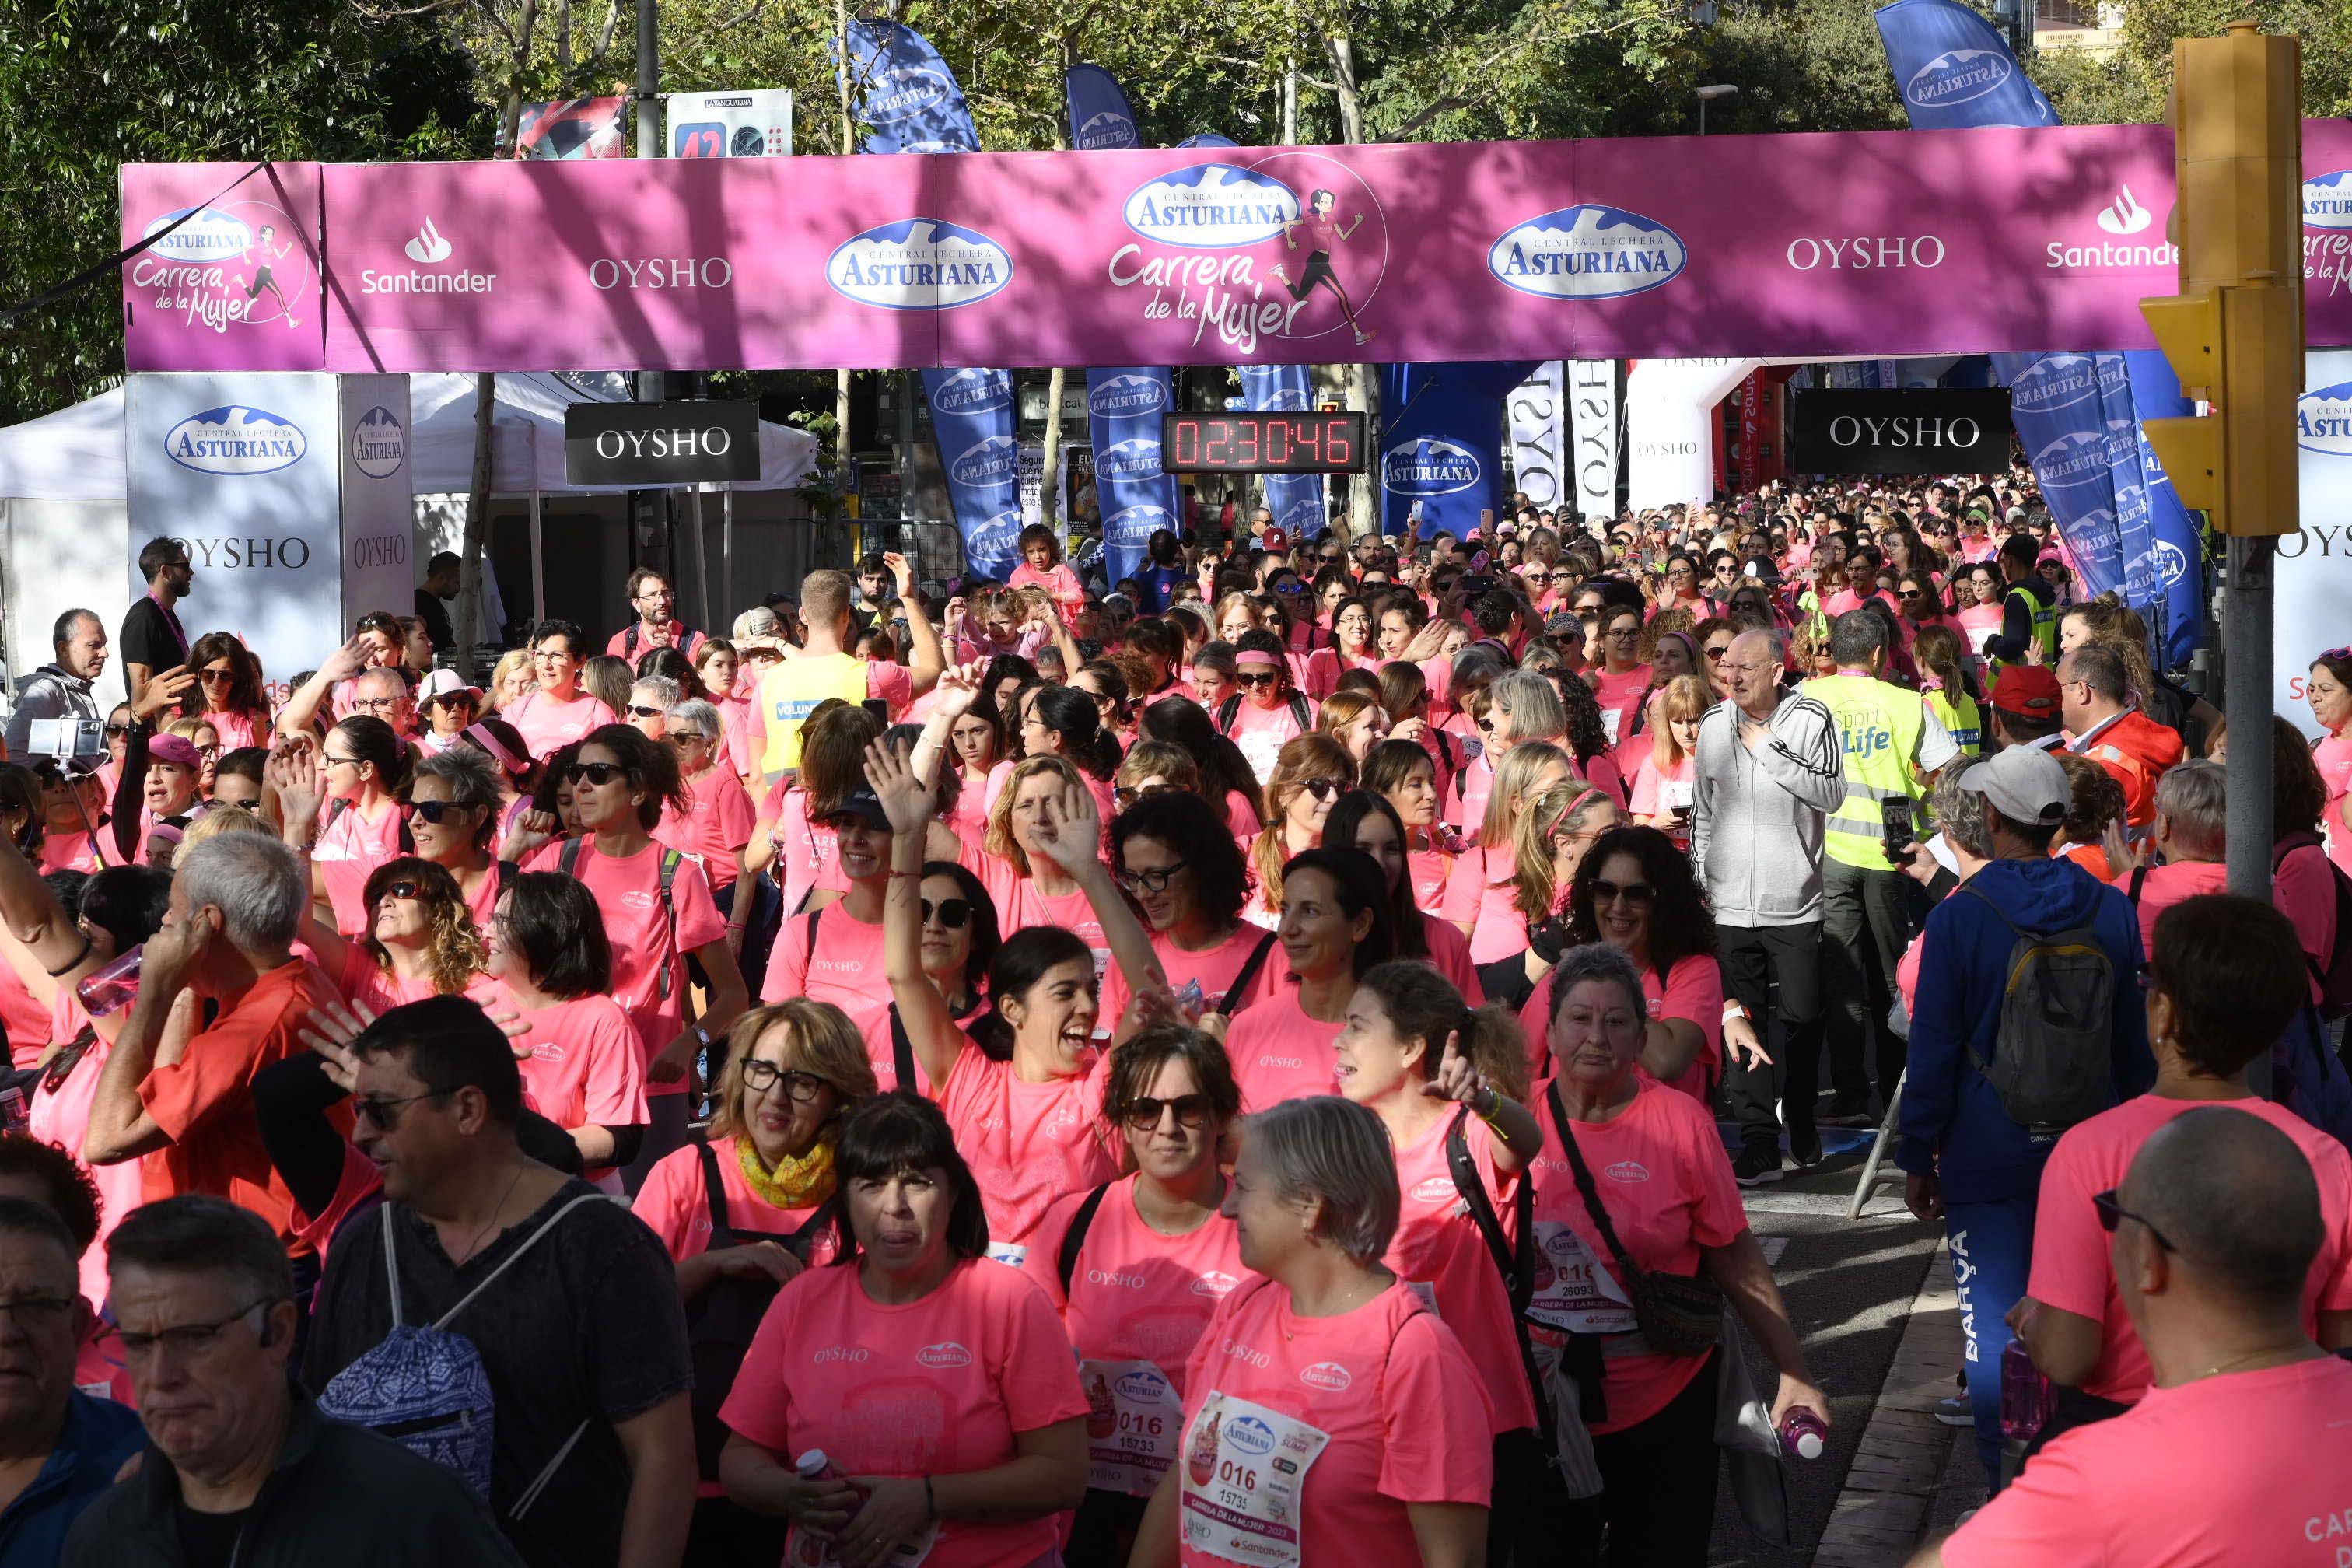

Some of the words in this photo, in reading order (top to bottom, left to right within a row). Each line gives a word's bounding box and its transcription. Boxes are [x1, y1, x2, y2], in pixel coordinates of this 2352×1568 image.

[1137, 195, 1288, 227] ASTURIANA
[1533, 236, 1597, 248] CENTRAL
[1601, 236, 1666, 246] LECHERA
[1787, 236, 1945, 271] OYSHO
[869, 249, 928, 259] CENTRAL
[934, 249, 992, 258] LECHERA
[1108, 244, 1255, 287] Carrera
[1503, 242, 1671, 277] ASTURIANA
[132, 258, 224, 288] Carrera
[588, 257, 732, 290] OYSHO
[841, 254, 999, 286] ASTURIANA
[361, 269, 496, 295] Santander
[155, 289, 173, 309] de
[176, 289, 188, 309] la
[186, 285, 259, 334] Mujer
[1144, 289, 1171, 319] de
[1176, 288, 1196, 319] la
[1193, 281, 1308, 354] Mujer
[245, 429, 292, 437] LECHERA
[595, 426, 730, 460] OYSHO
[1175, 421, 1349, 464] 02:30:46
[1829, 415, 1979, 448] OYSHO
[176, 432, 297, 458] ASTURIANA
[356, 434, 402, 461] ASTURIANA
[1638, 441, 1697, 457] OYSHO
[1020, 454, 1045, 466] Segur
[1386, 462, 1473, 484] ASTURIANA
[1021, 487, 1041, 496] mete
[354, 534, 406, 569] OYSHO
[1832, 708, 1880, 730] Sport
[1841, 726, 1890, 759] Life
[817, 960, 861, 972] OYSHO
[1259, 1055, 1302, 1069] OYSHO
[1088, 1269, 1146, 1289] OYSHO
[1562, 1285, 1594, 1297] 26093
[1948, 1229, 1979, 1363] BARÇA
[1530, 1300, 1564, 1308] CARRERA
[813, 1346, 869, 1364] OYSHO
[919, 1350, 968, 1363] ASTURIANA
[1302, 1367, 1347, 1387] ASTURIANA
[1118, 1412, 1163, 1435] 016
[1119, 1437, 1155, 1453] 15733
[1226, 1424, 1269, 1451] ASTURIANA
[1220, 1460, 1257, 1491] 016
[1219, 1489, 1248, 1511] 15735
[1237, 1516, 1265, 1531] MUJER
[1241, 1539, 1290, 1559] Santander
